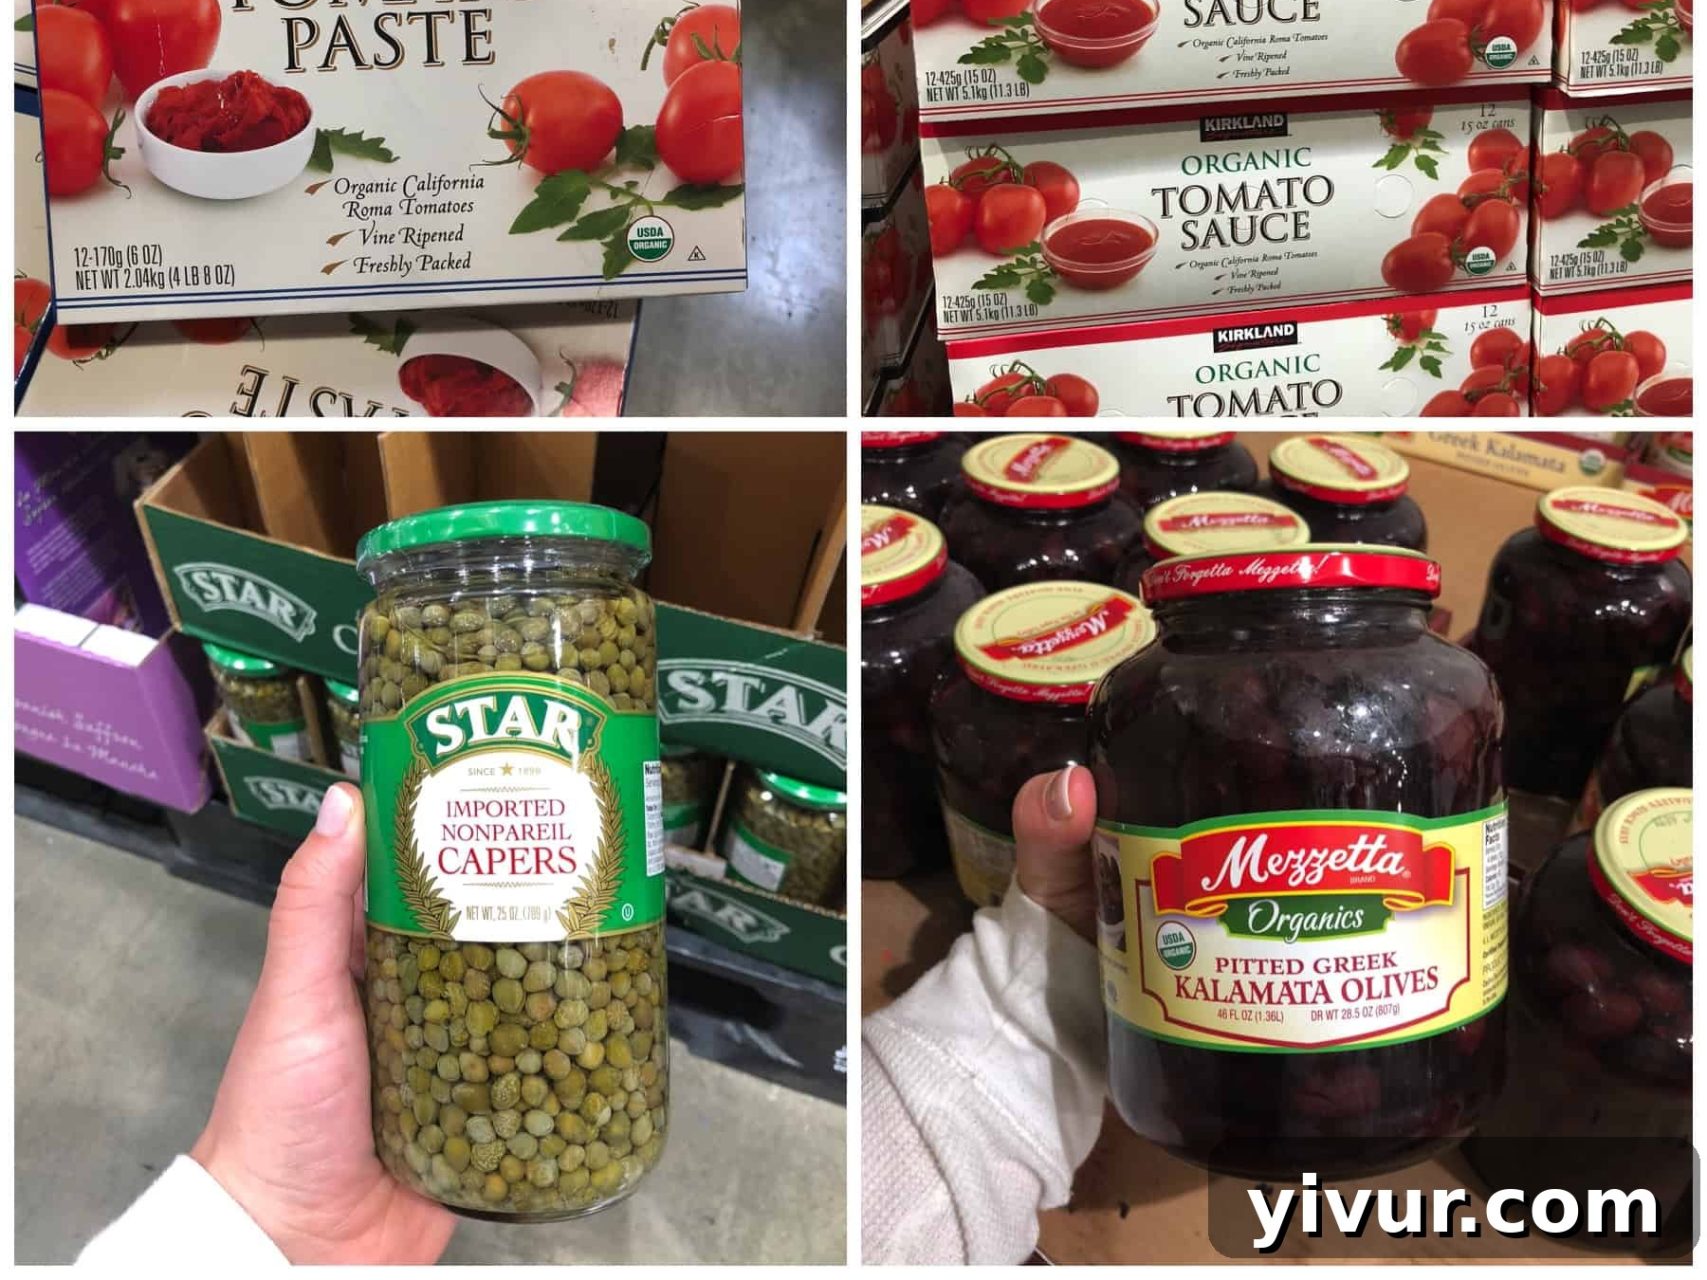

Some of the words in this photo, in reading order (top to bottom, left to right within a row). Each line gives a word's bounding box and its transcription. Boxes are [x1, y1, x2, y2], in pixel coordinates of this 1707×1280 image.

[281, 9, 496, 73] PASTE
[1181, 147, 1312, 175] ORGANIC
[334, 178, 397, 200] Organic
[402, 172, 485, 198] California
[1151, 175, 1335, 219] TOMATO
[342, 201, 392, 220] Roma
[399, 199, 474, 215] Tomatoes
[359, 220, 395, 246] Vine
[398, 223, 464, 249] Ripened
[637, 227, 663, 237] USDA
[1181, 210, 1310, 251] SAUCE
[74, 246, 123, 268] 12-170g
[127, 245, 138, 267] (6
[142, 244, 162, 267] OZ)
[633, 241, 667, 249] ORGANIC
[76, 271, 98, 290] NET
[101, 270, 120, 289] WT
[124, 268, 165, 289] 2.04kg
[169, 267, 180, 289] (4
[185, 266, 199, 286] LB
[204, 265, 211, 285] 8
[215, 265, 235, 287] OZ)
[353, 254, 412, 278] Freshly
[415, 251, 472, 271] Packed
[188, 570, 297, 628] STAR
[426, 695, 580, 756] STAR
[468, 768, 496, 776] SINCE
[447, 799, 565, 817] IMPORTED
[441, 823, 572, 841] NONPAREIL
[438, 847, 577, 876] CAPERS
[1201, 833, 1406, 892] Mezzetta
[1247, 899, 1365, 943] Organics
[1162, 932, 1185, 946] USDA
[1215, 957, 1305, 975] PITTED
[1313, 952, 1397, 973] GREEK
[1175, 975, 1333, 1005] KALAMATA
[1341, 966, 1439, 1001] OLIVES
[1230, 1009, 1238, 1019] FL
[1242, 1011, 1252, 1021] OZ
[1311, 1011, 1323, 1021] DR
[1325, 1009, 1338, 1020] WT
[1362, 1007, 1373, 1018] OZ
